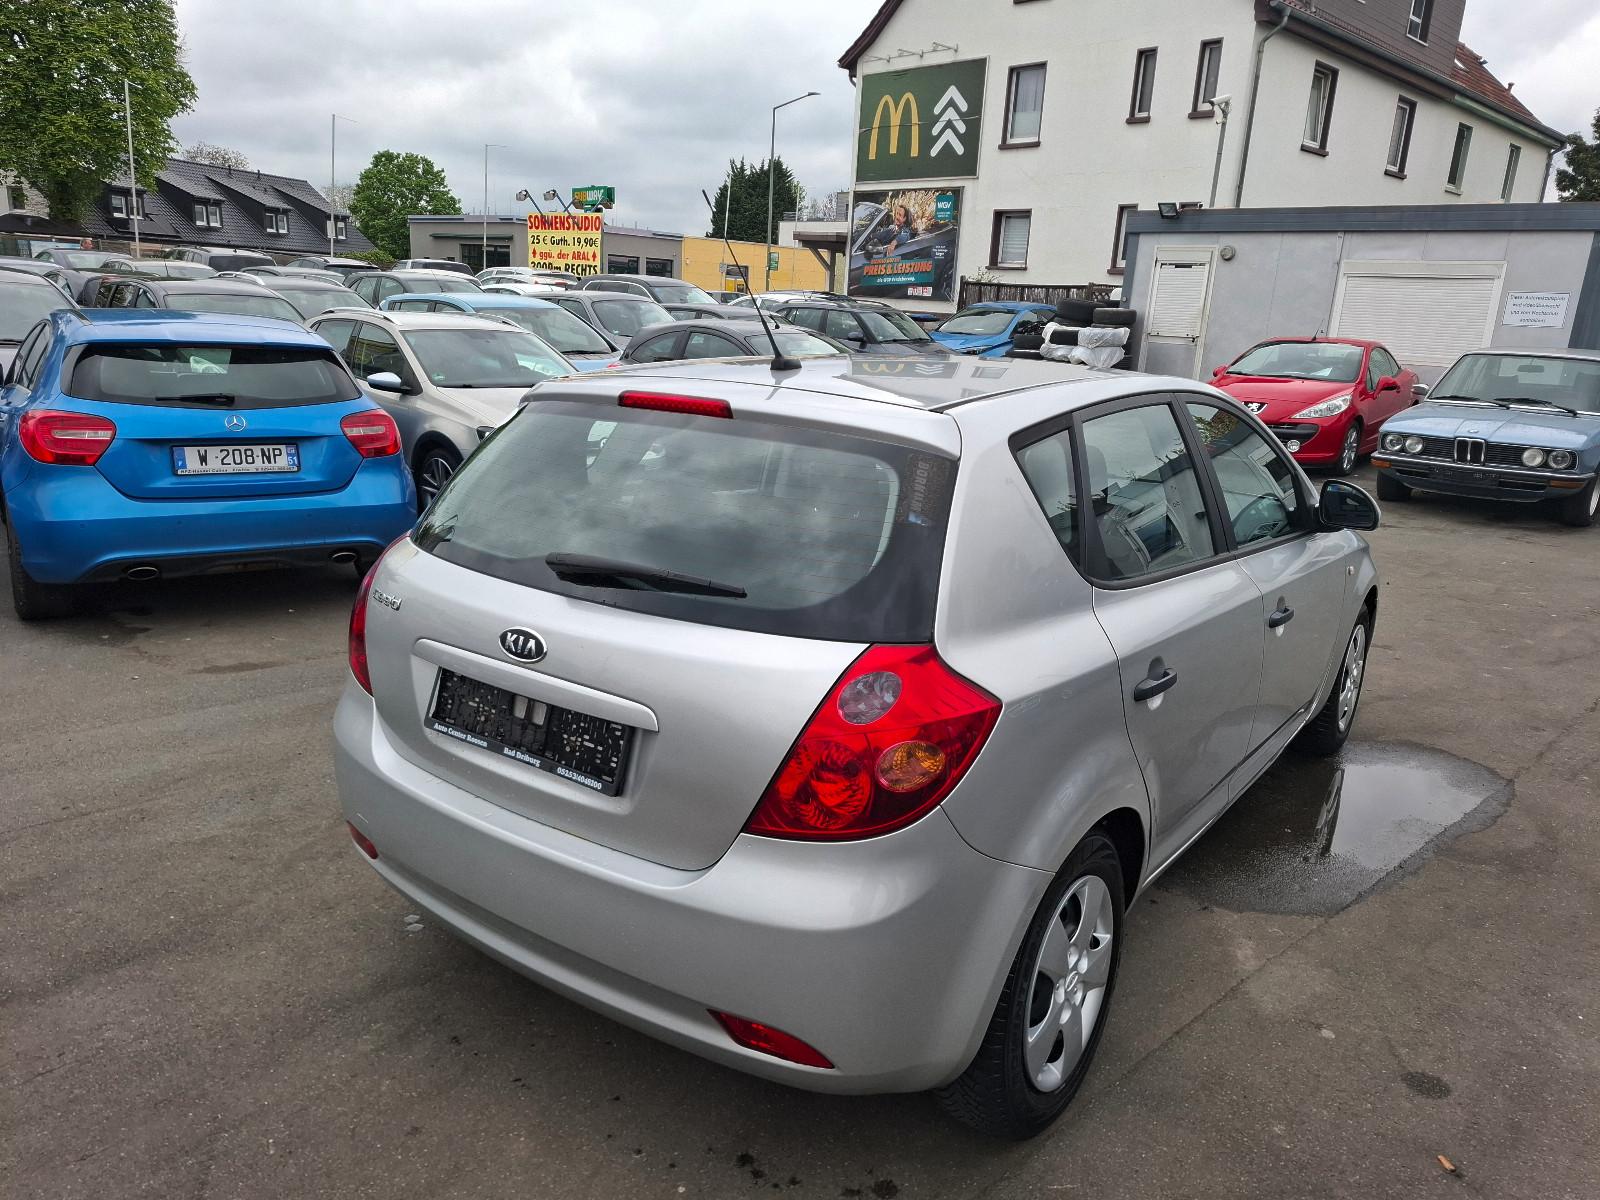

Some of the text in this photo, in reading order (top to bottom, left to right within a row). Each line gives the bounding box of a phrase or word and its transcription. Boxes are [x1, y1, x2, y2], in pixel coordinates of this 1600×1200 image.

[574, 189, 603, 201] SUBWAY
[937, 201, 952, 209] WGV
[528, 215, 600, 231] SONNENSTUDIO
[530, 235, 540, 245] 25
[543, 236, 548, 245] €
[550, 236, 570, 247] Guth.
[557, 249, 569, 260] der
[571, 251, 590, 261] ARAL
[564, 263, 598, 277] RECHTS
[863, 264, 886, 276] PREIS
[894, 260, 933, 274] LEISTUNG
[288, 456, 298, 464] 51
[505, 631, 537, 659] KIA
[433, 722, 448, 734] Auto
[448, 728, 466, 741] Center
[503, 746, 541, 767] Bad Driburg
